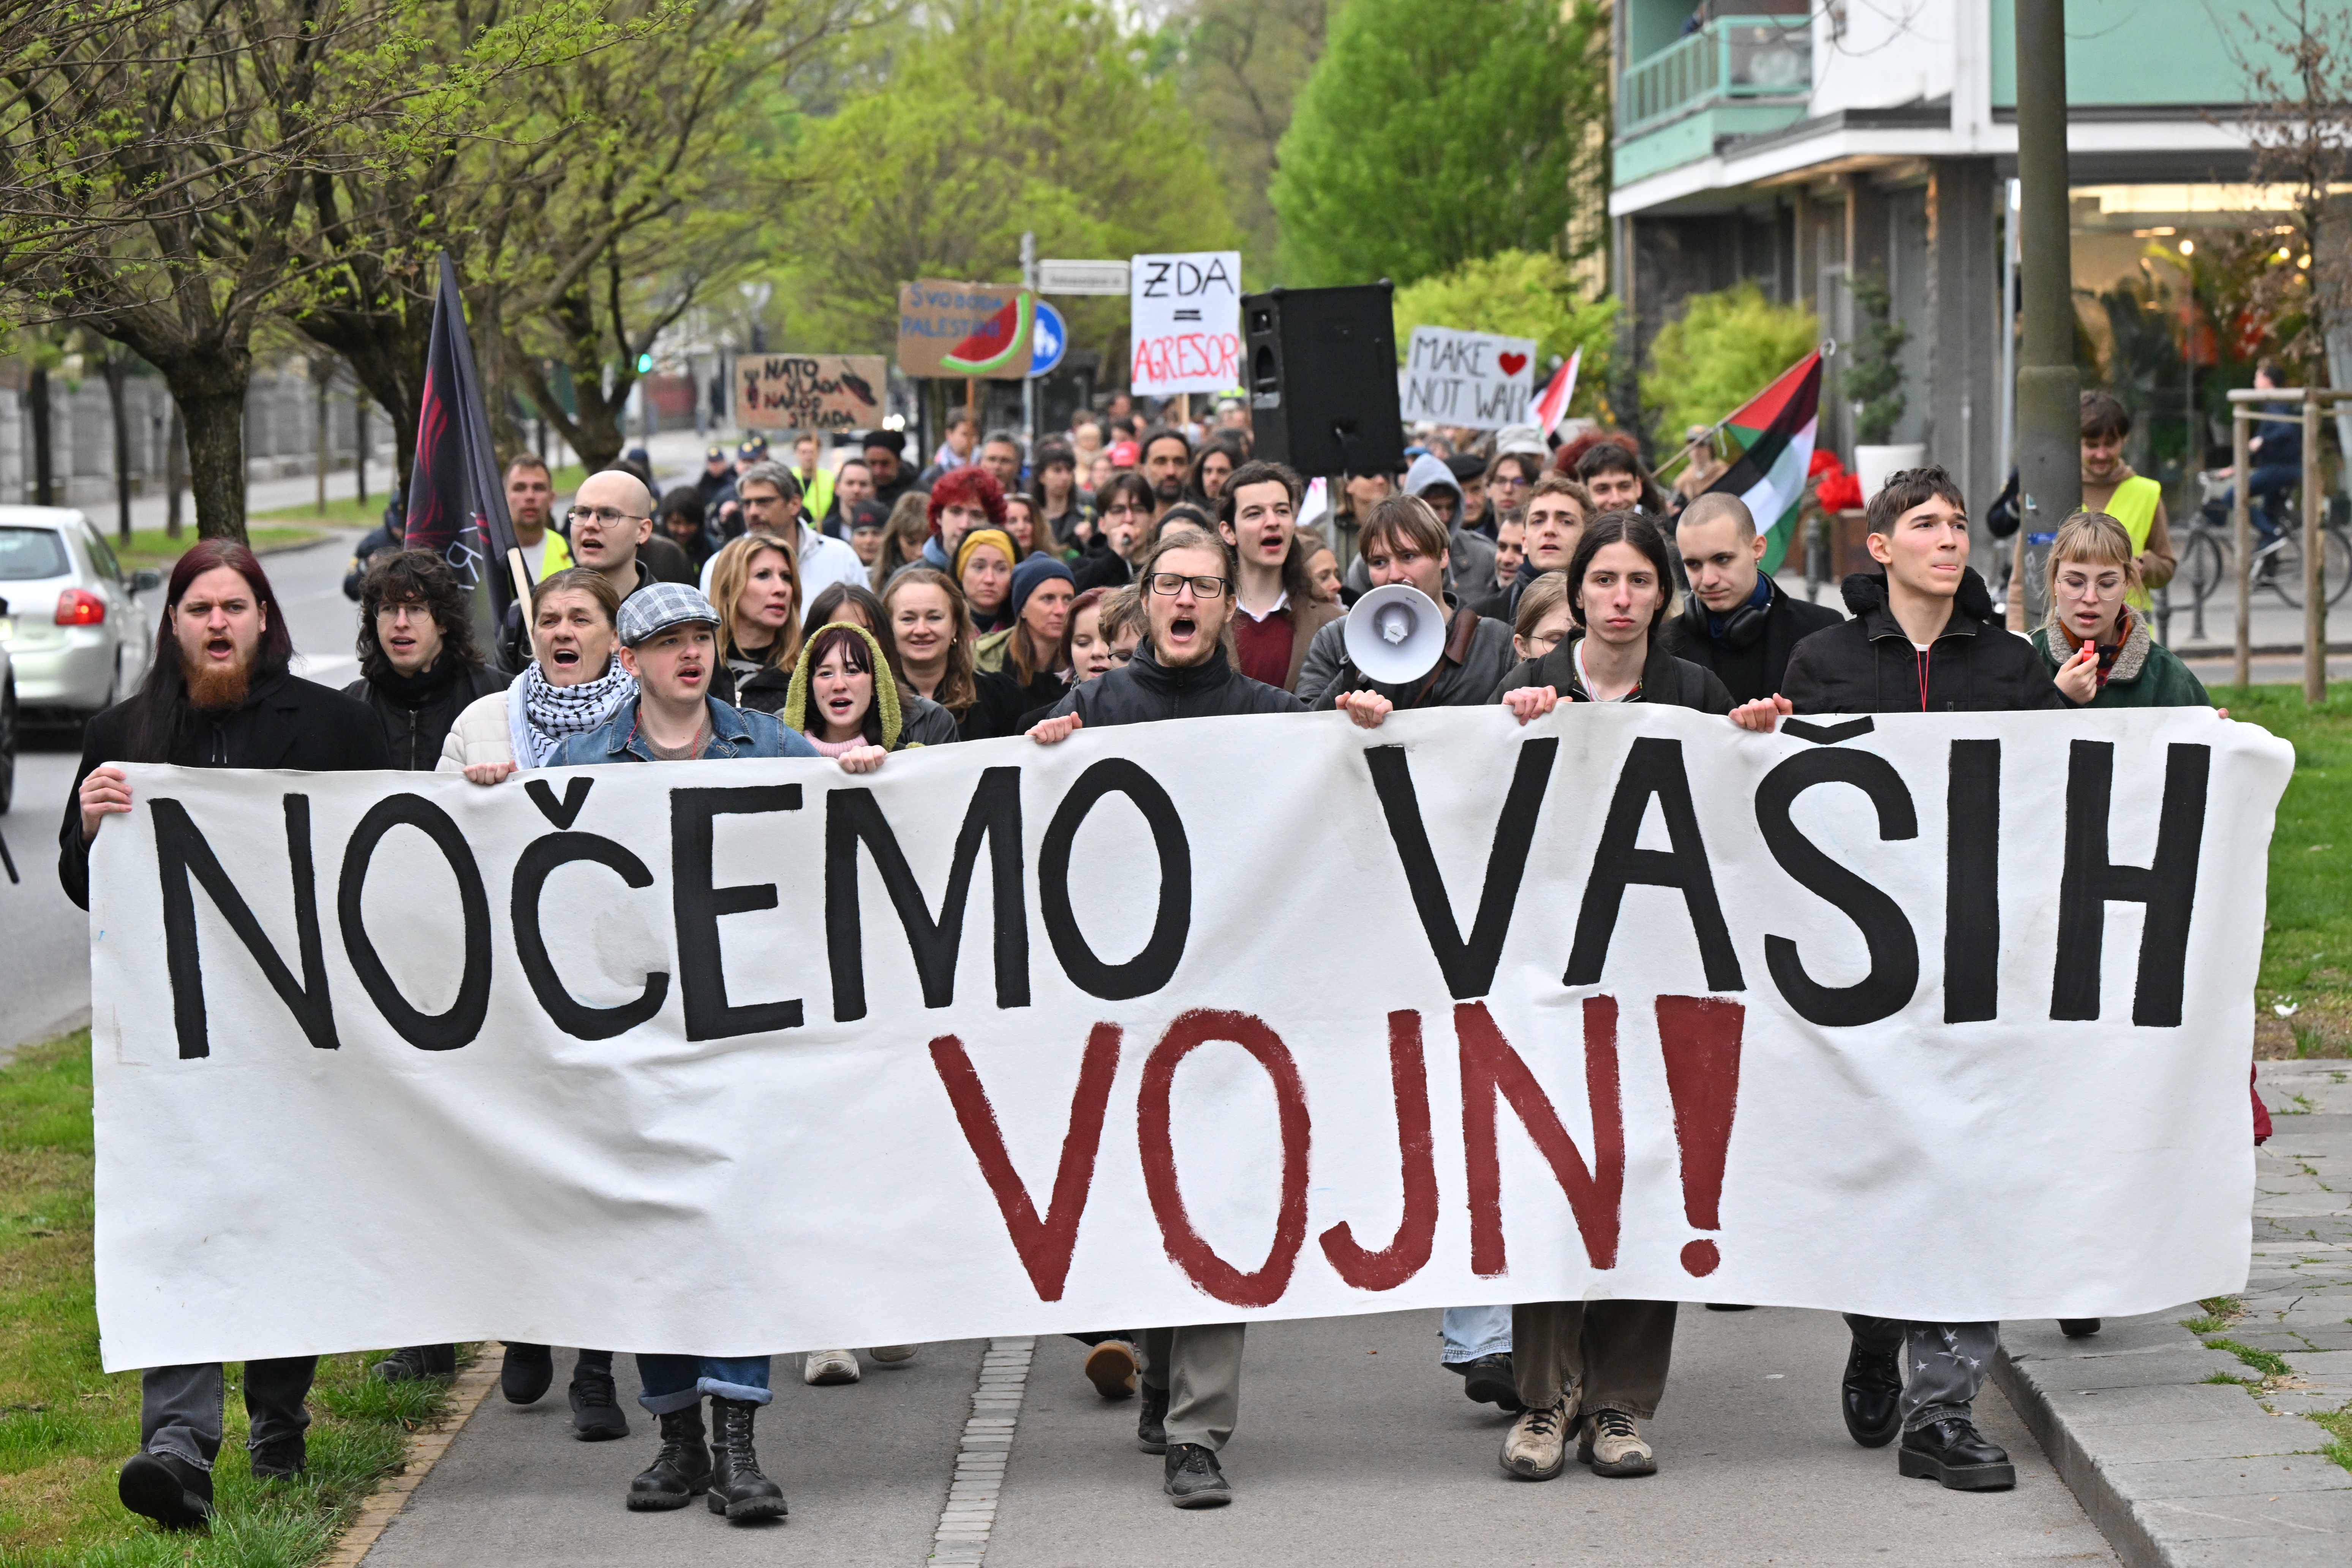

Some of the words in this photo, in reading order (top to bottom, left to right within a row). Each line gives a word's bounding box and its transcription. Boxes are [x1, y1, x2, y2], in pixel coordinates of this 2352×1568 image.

[909, 282, 1003, 311] SVOBODA
[1144, 258, 1234, 297] ZDA
[765, 358, 819, 379] NATO
[1132, 332, 1239, 386] AGRESOR
[1413, 336, 1492, 378] MAKE
[1407, 378, 1465, 417] NOT
[1475, 382, 1528, 424] WAR
[147, 758, 1191, 1059] NOČEMO
[1364, 716, 2210, 1027] VAŠIH
[931, 995, 1745, 1307] VOJN!
